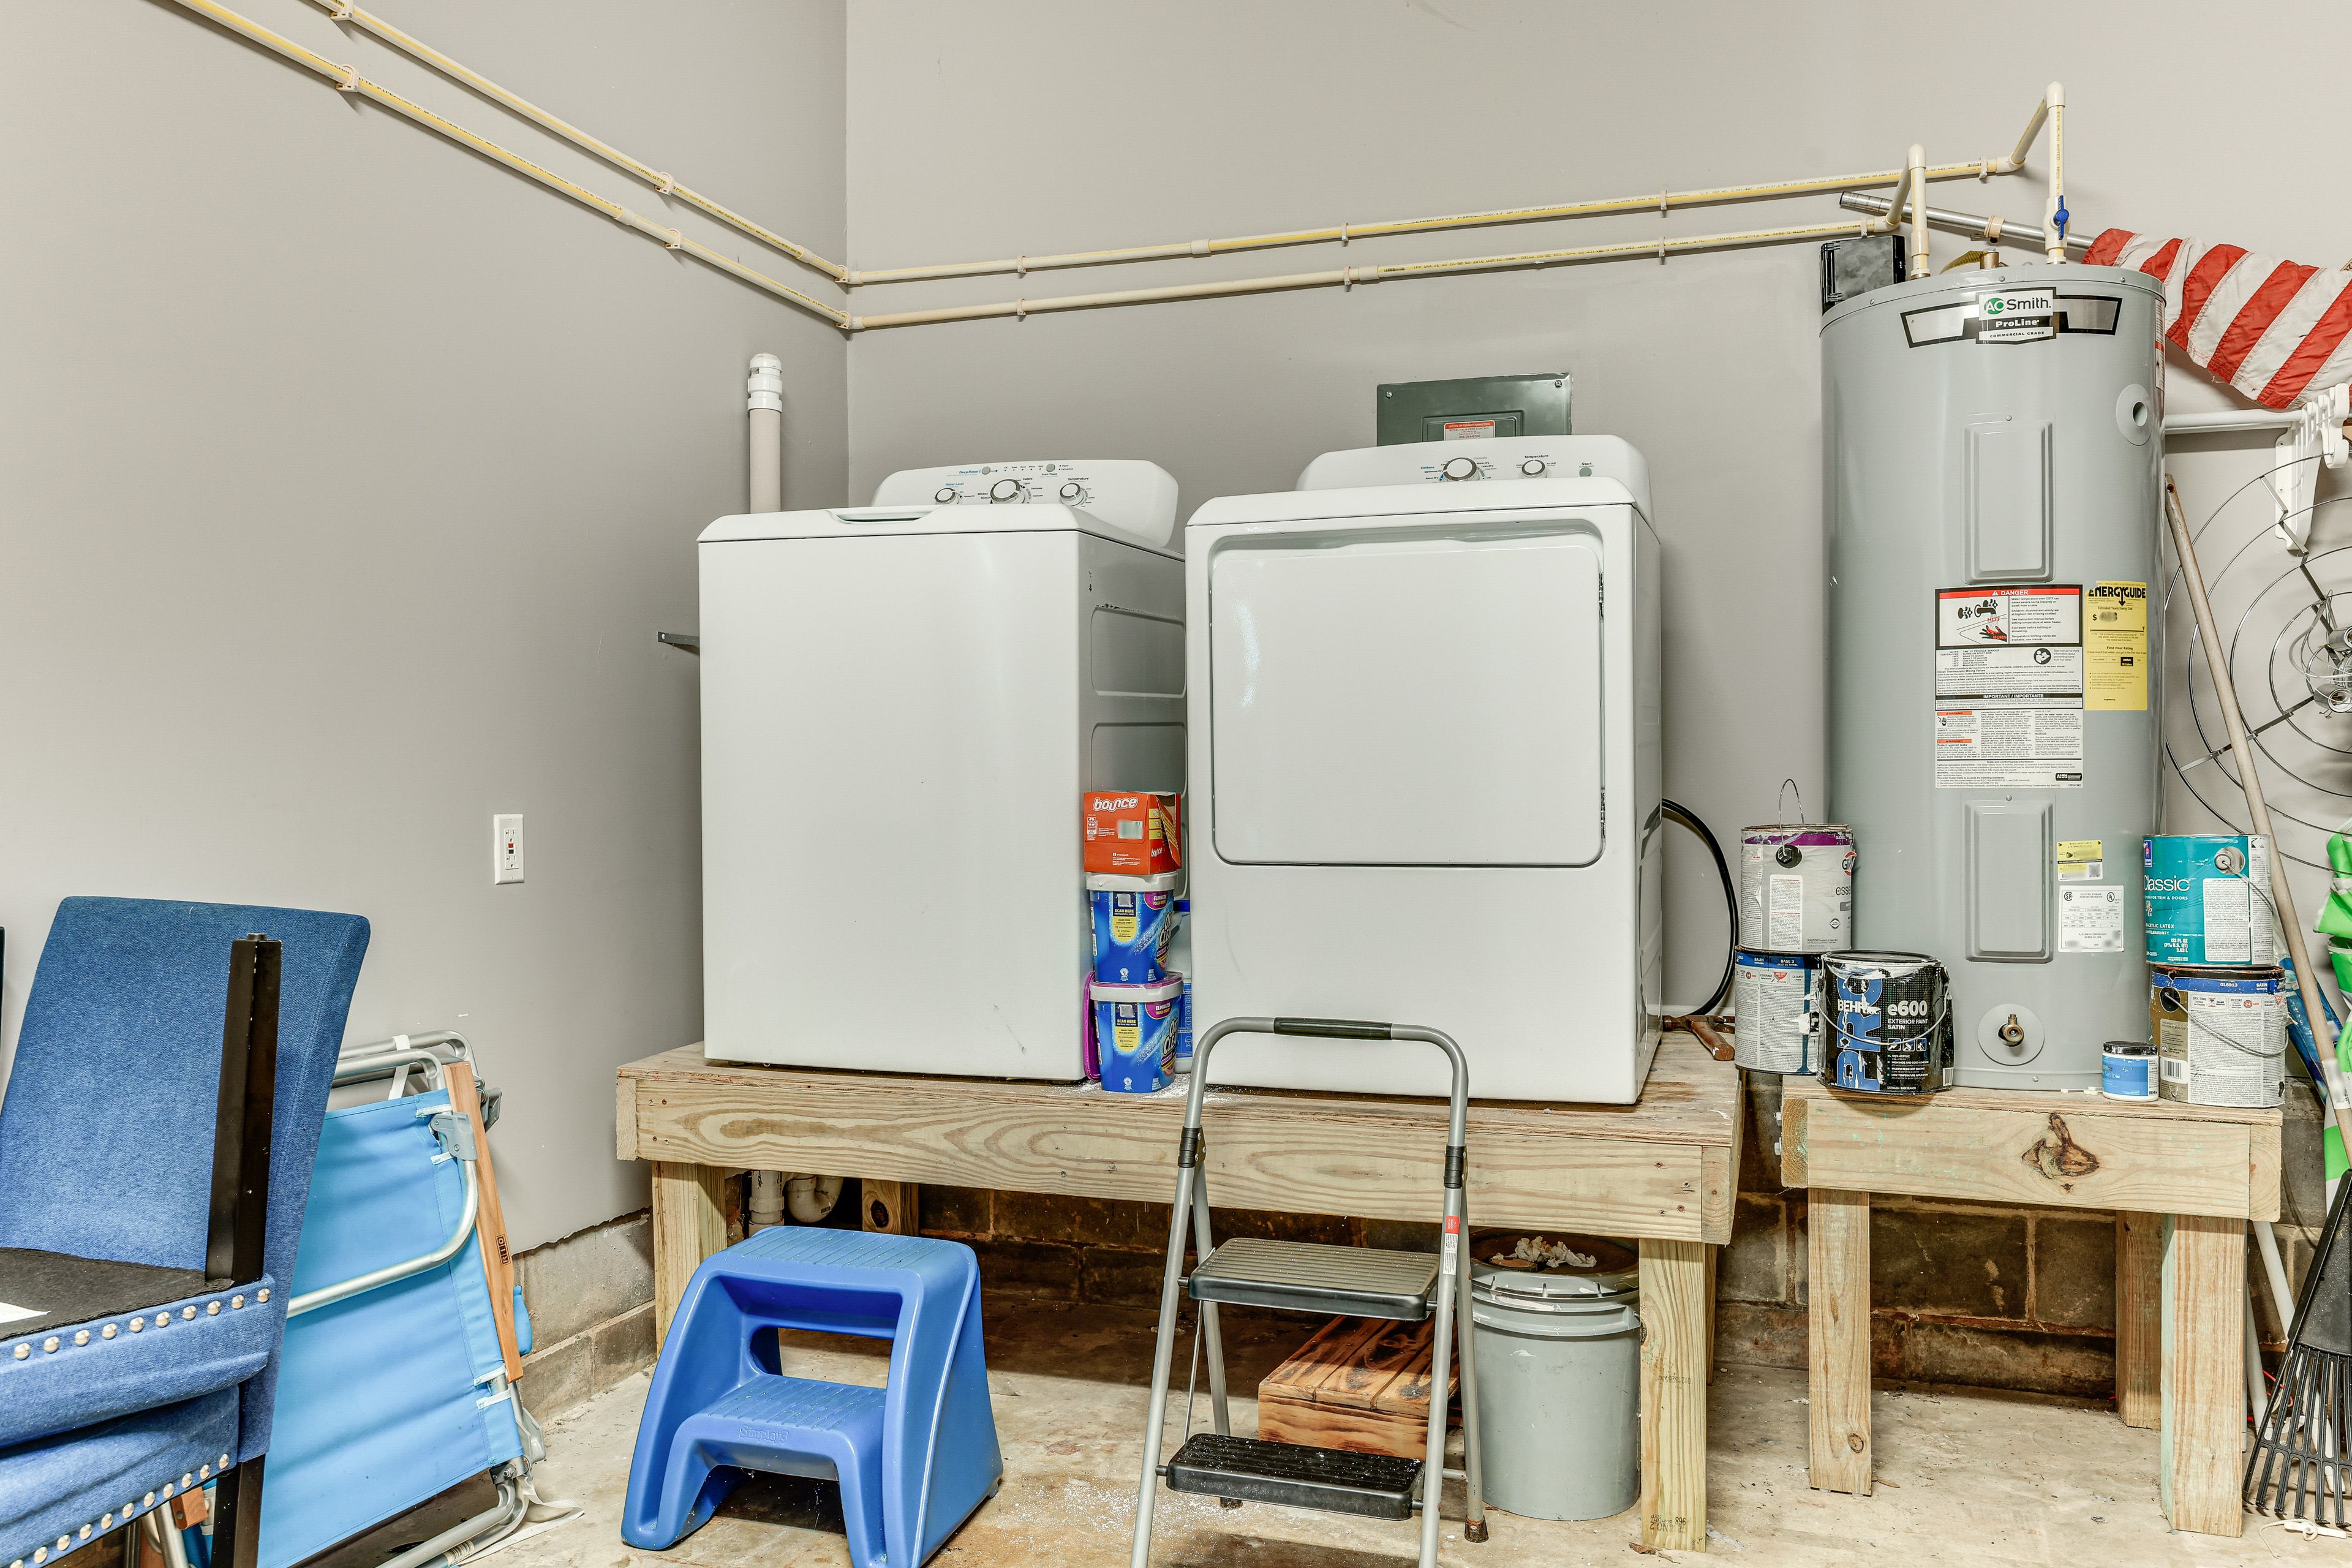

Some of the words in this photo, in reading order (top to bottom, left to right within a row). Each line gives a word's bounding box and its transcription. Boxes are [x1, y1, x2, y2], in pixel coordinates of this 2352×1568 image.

[635, 166, 667, 185] CHARLOTTE
[2089, 586, 2146, 598] ENERGYGUIDE
[1093, 797, 1138, 812] bounce
[2144, 875, 2190, 891] Classic
[1887, 1000, 1928, 1016] e600
[498, 1237, 508, 1264] RIO
[739, 1425, 789, 1443] Simplay3
